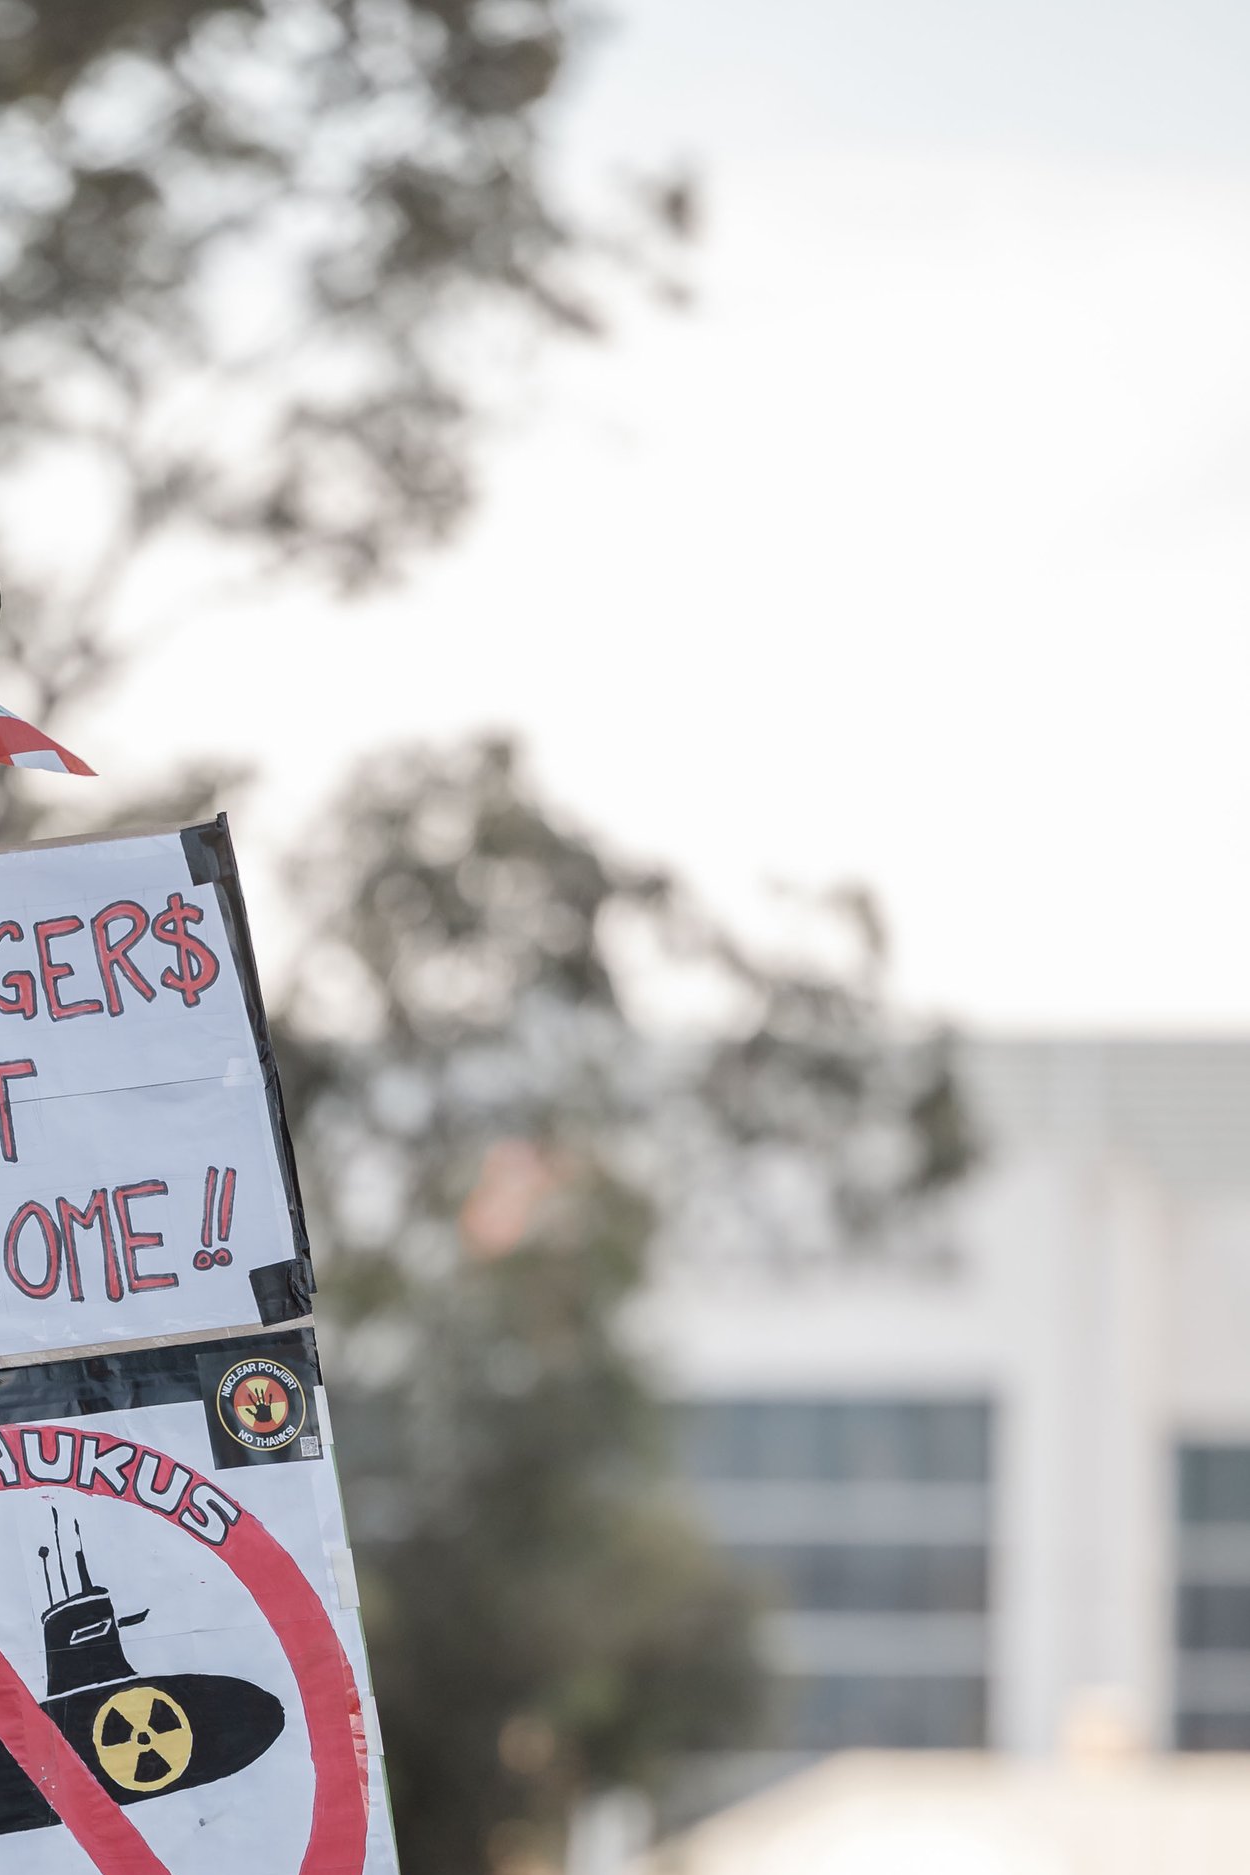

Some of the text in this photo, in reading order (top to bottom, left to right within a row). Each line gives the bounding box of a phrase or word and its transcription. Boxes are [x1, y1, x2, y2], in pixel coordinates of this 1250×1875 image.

[221, 1362, 297, 1397] NUCLEAR POWER?
[238, 1425, 296, 1447] NO THANKS!
